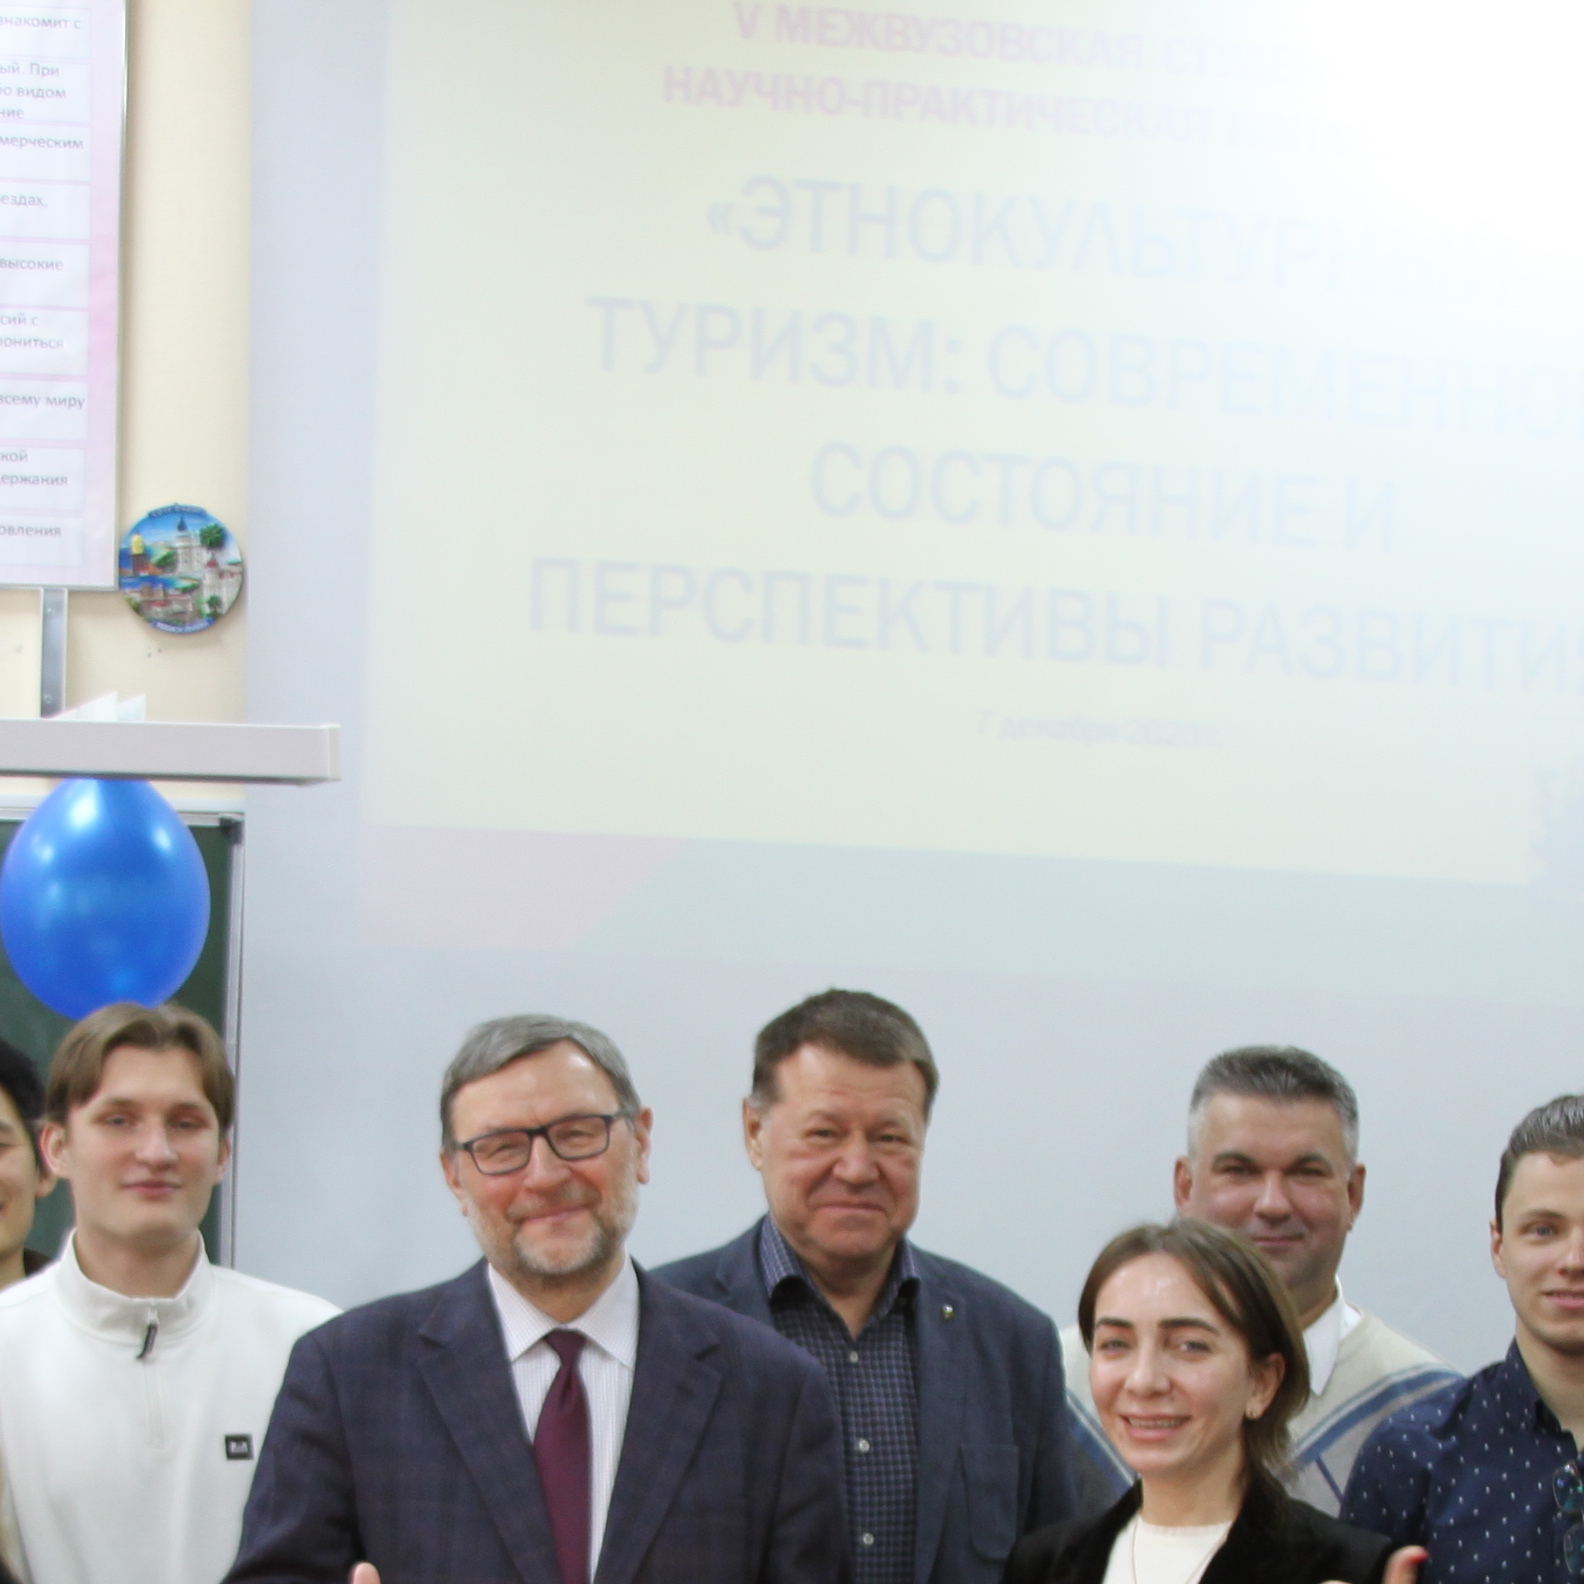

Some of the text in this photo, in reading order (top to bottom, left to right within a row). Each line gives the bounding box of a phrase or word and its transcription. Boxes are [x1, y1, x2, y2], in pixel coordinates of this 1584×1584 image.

[30, 64, 59, 78] При
[16, 87, 66, 100] видом
[0, 258, 63, 271] высокие
[586, 293, 963, 396] ТУРИЗМ:
[46, 396, 85, 410] миру
[810, 441, 1395, 553] СОСТОЯНИЕ И
[529, 556, 1171, 669] ПЕРСПЕКТИВЫ
